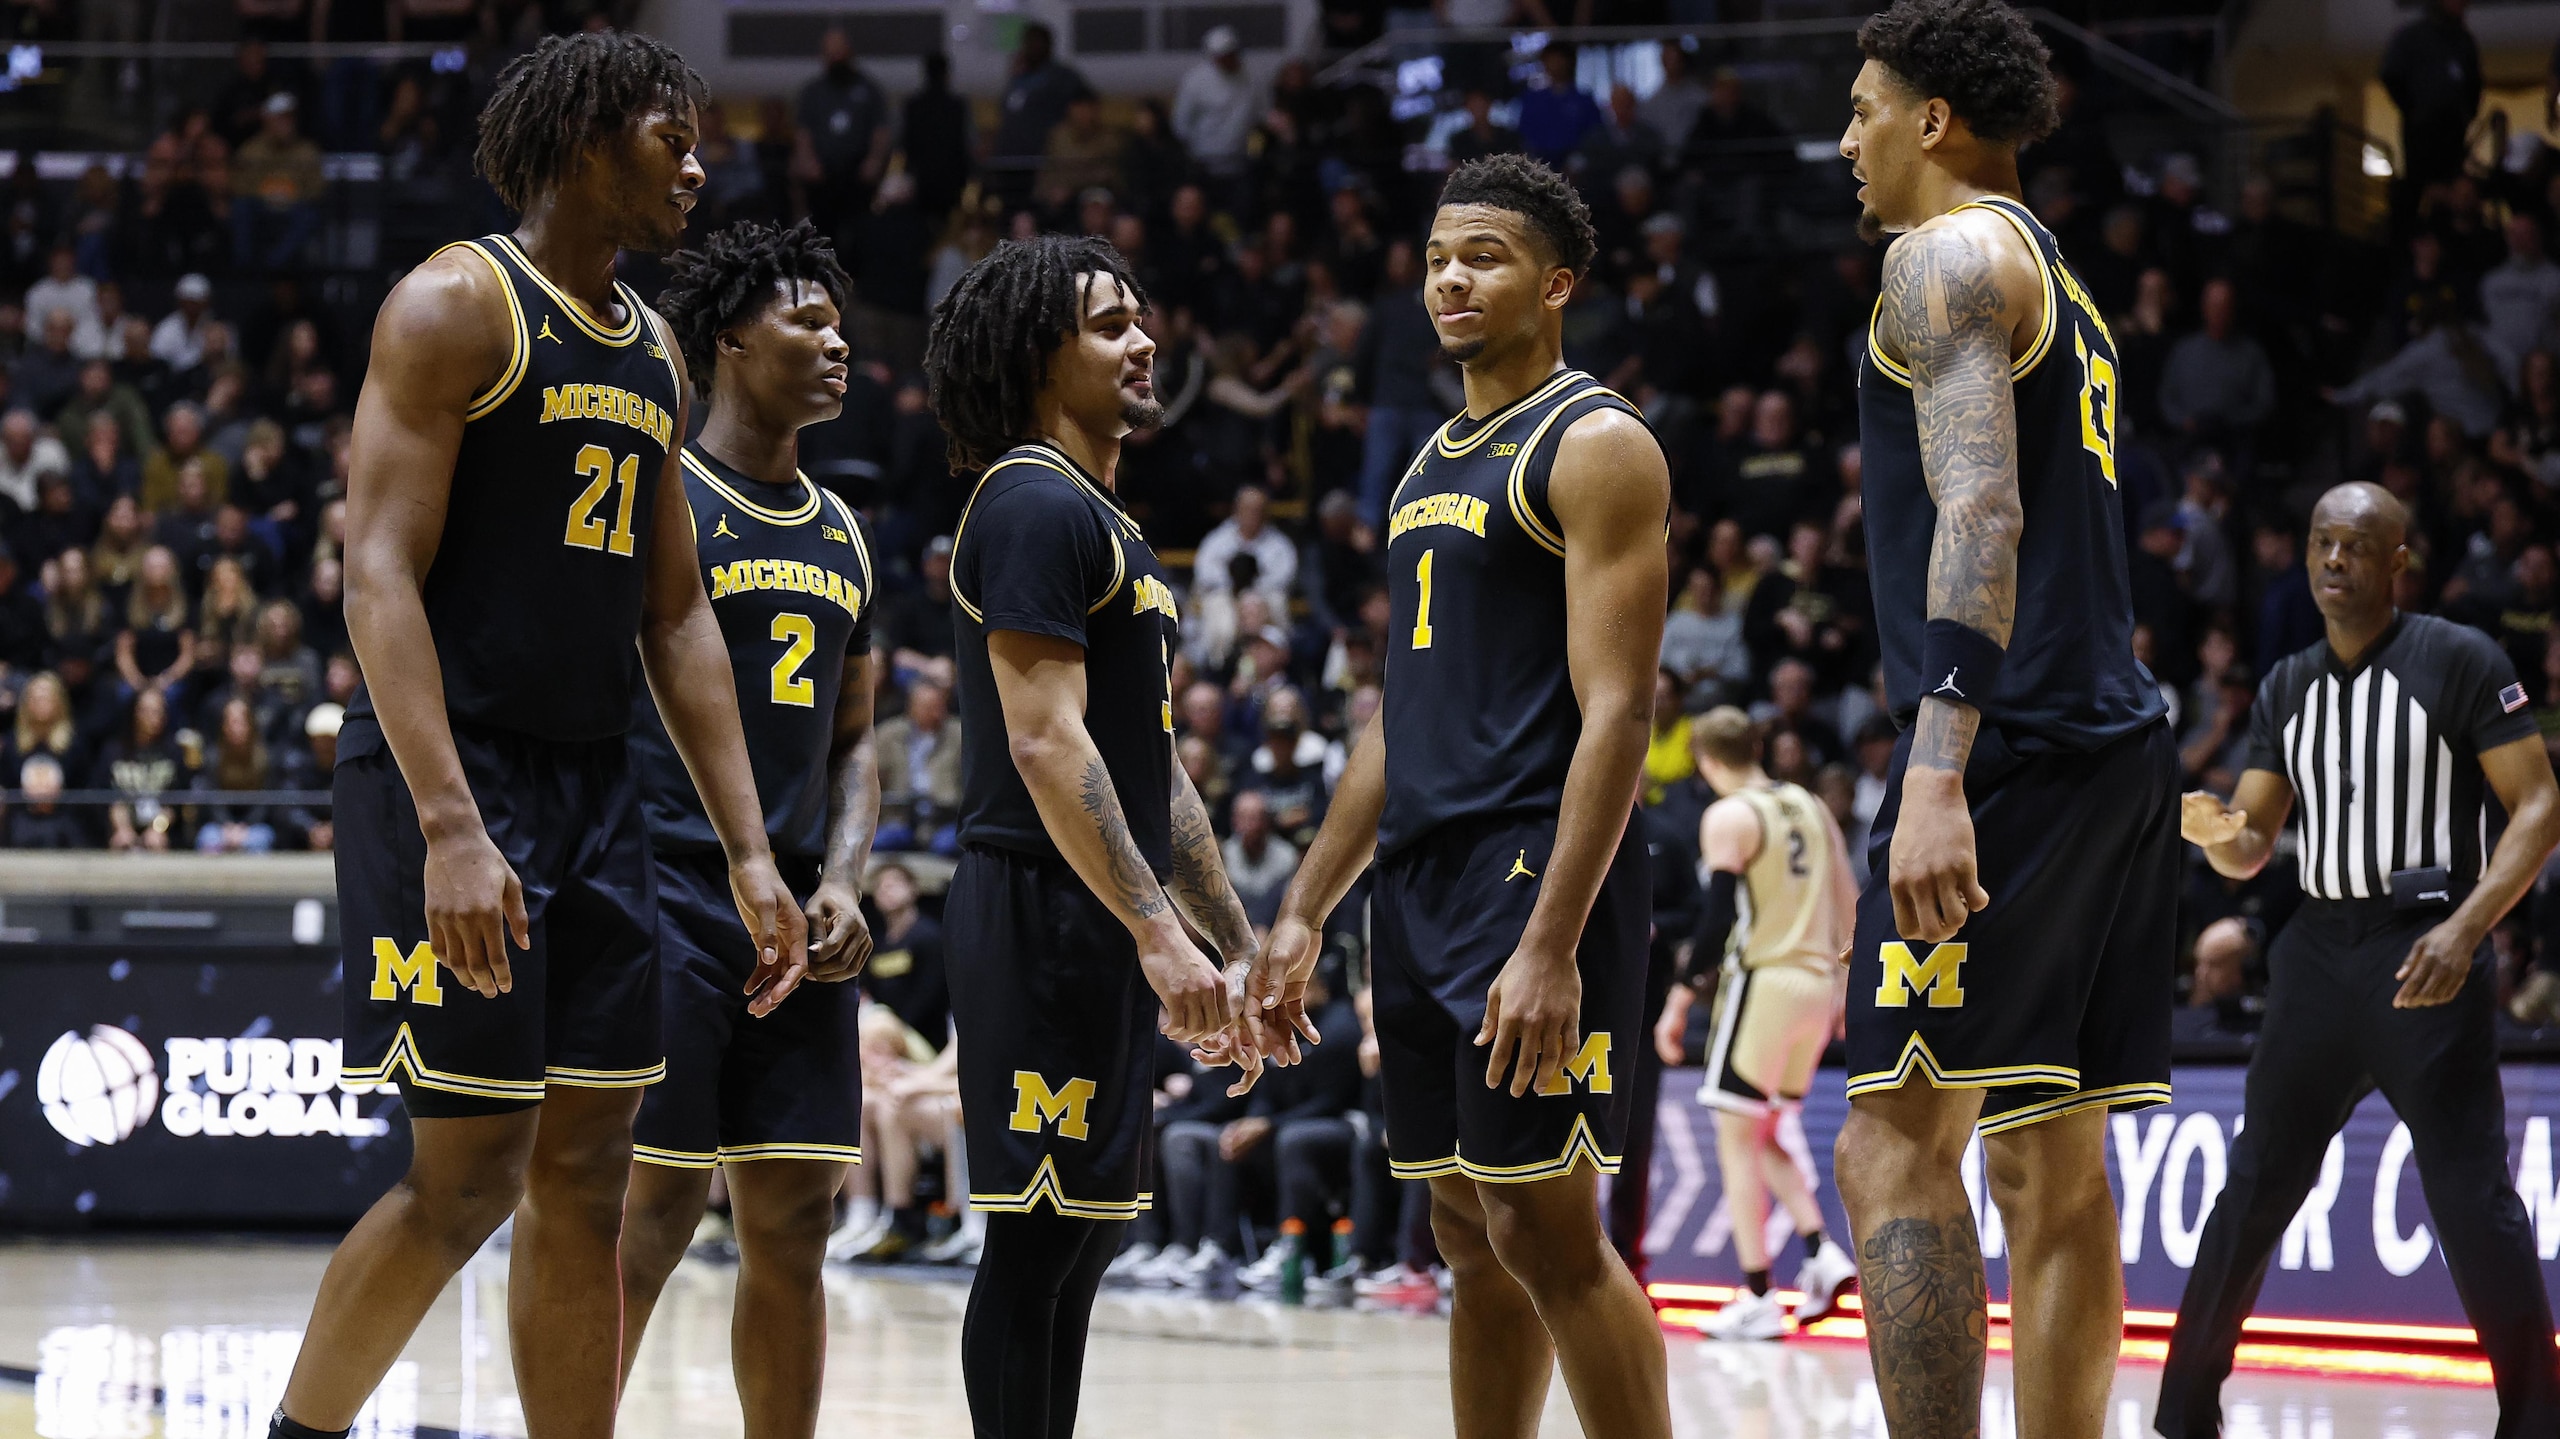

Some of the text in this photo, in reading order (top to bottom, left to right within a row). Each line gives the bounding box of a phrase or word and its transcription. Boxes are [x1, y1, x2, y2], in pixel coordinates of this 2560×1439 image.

[539, 383, 674, 455] MICHIGAN
[564, 443, 640, 558] 21
[711, 558, 862, 624] MICHIGAN
[1412, 548, 1434, 650] 1
[770, 612, 816, 709] 2
[1788, 828, 1811, 878] 2
[370, 936, 443, 1007] M
[1875, 940, 1969, 1008] M
[1537, 1031, 1612, 1097] M
[1009, 1069, 1097, 1142] M
[2110, 1111, 2346, 1272] YOR
